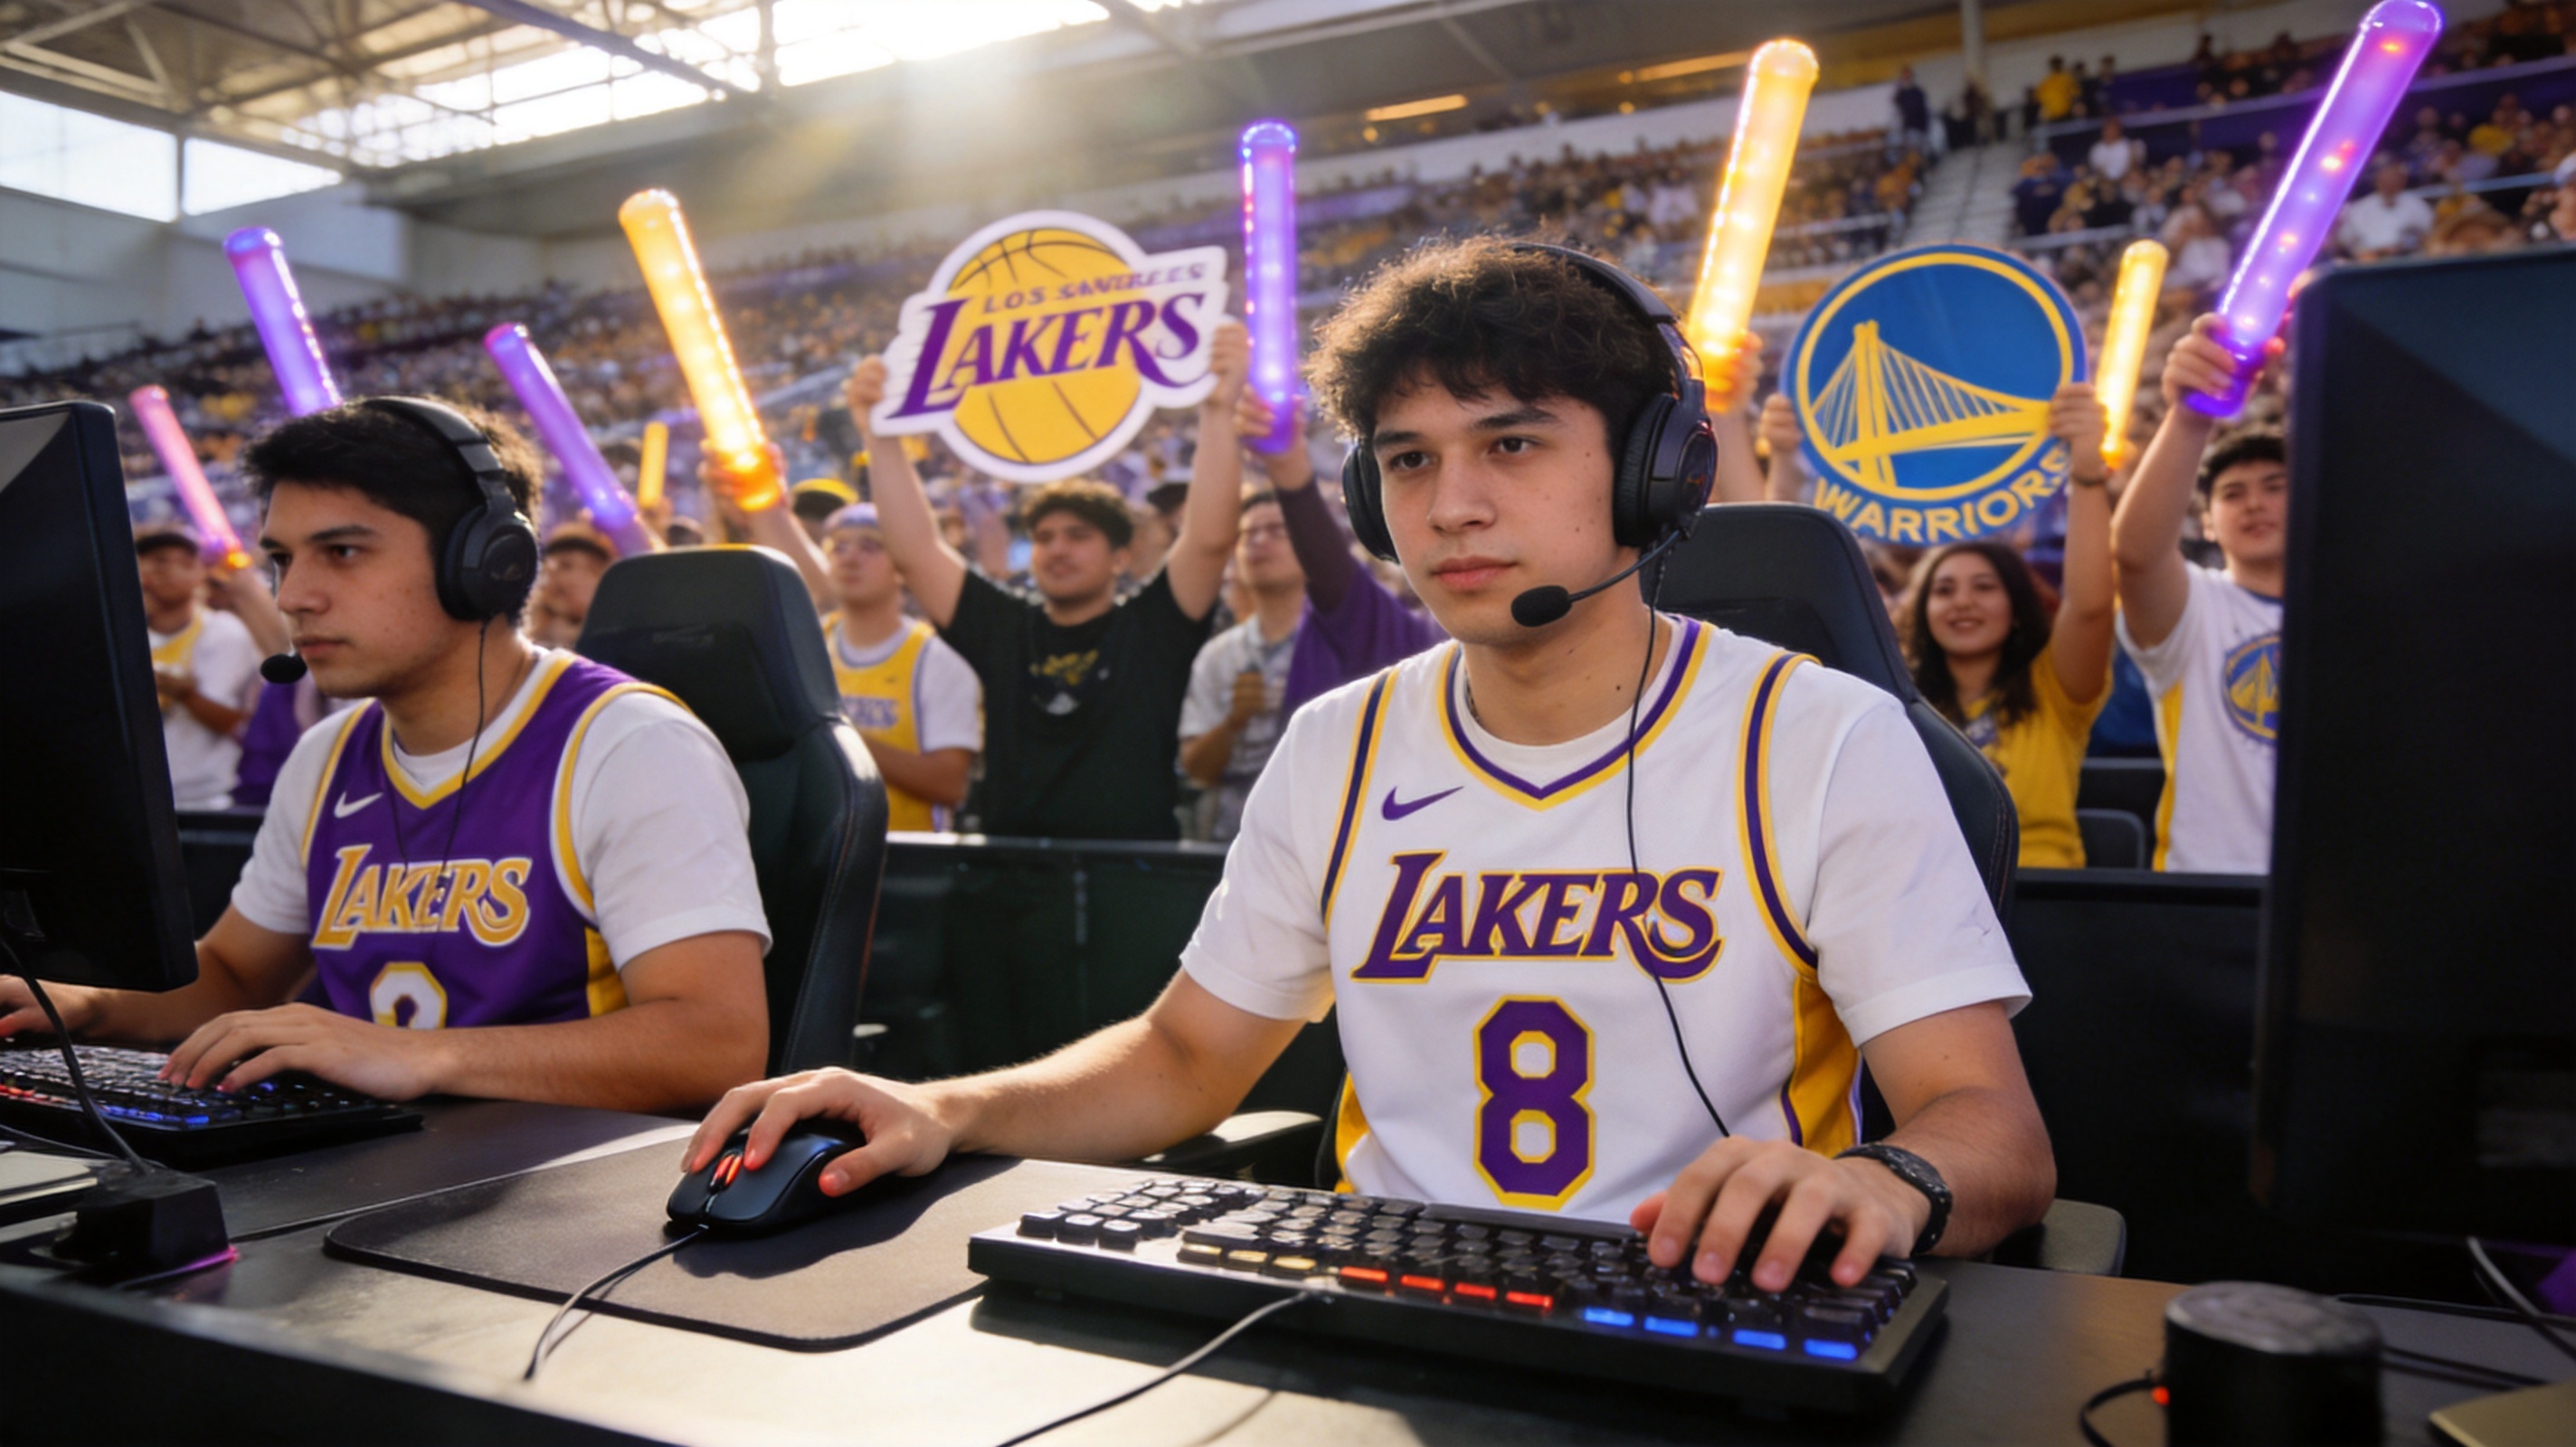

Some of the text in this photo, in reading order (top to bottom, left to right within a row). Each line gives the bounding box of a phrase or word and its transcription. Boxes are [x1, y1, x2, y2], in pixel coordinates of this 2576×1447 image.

[885, 291, 1214, 420] LAKERS
[983, 287, 1046, 315] LOS
[1814, 447, 2068, 543] WARRIORS
[309, 843, 532, 950] LAKERS
[1350, 849, 1725, 984] LAKERS
[1473, 995, 1596, 1211] 8
